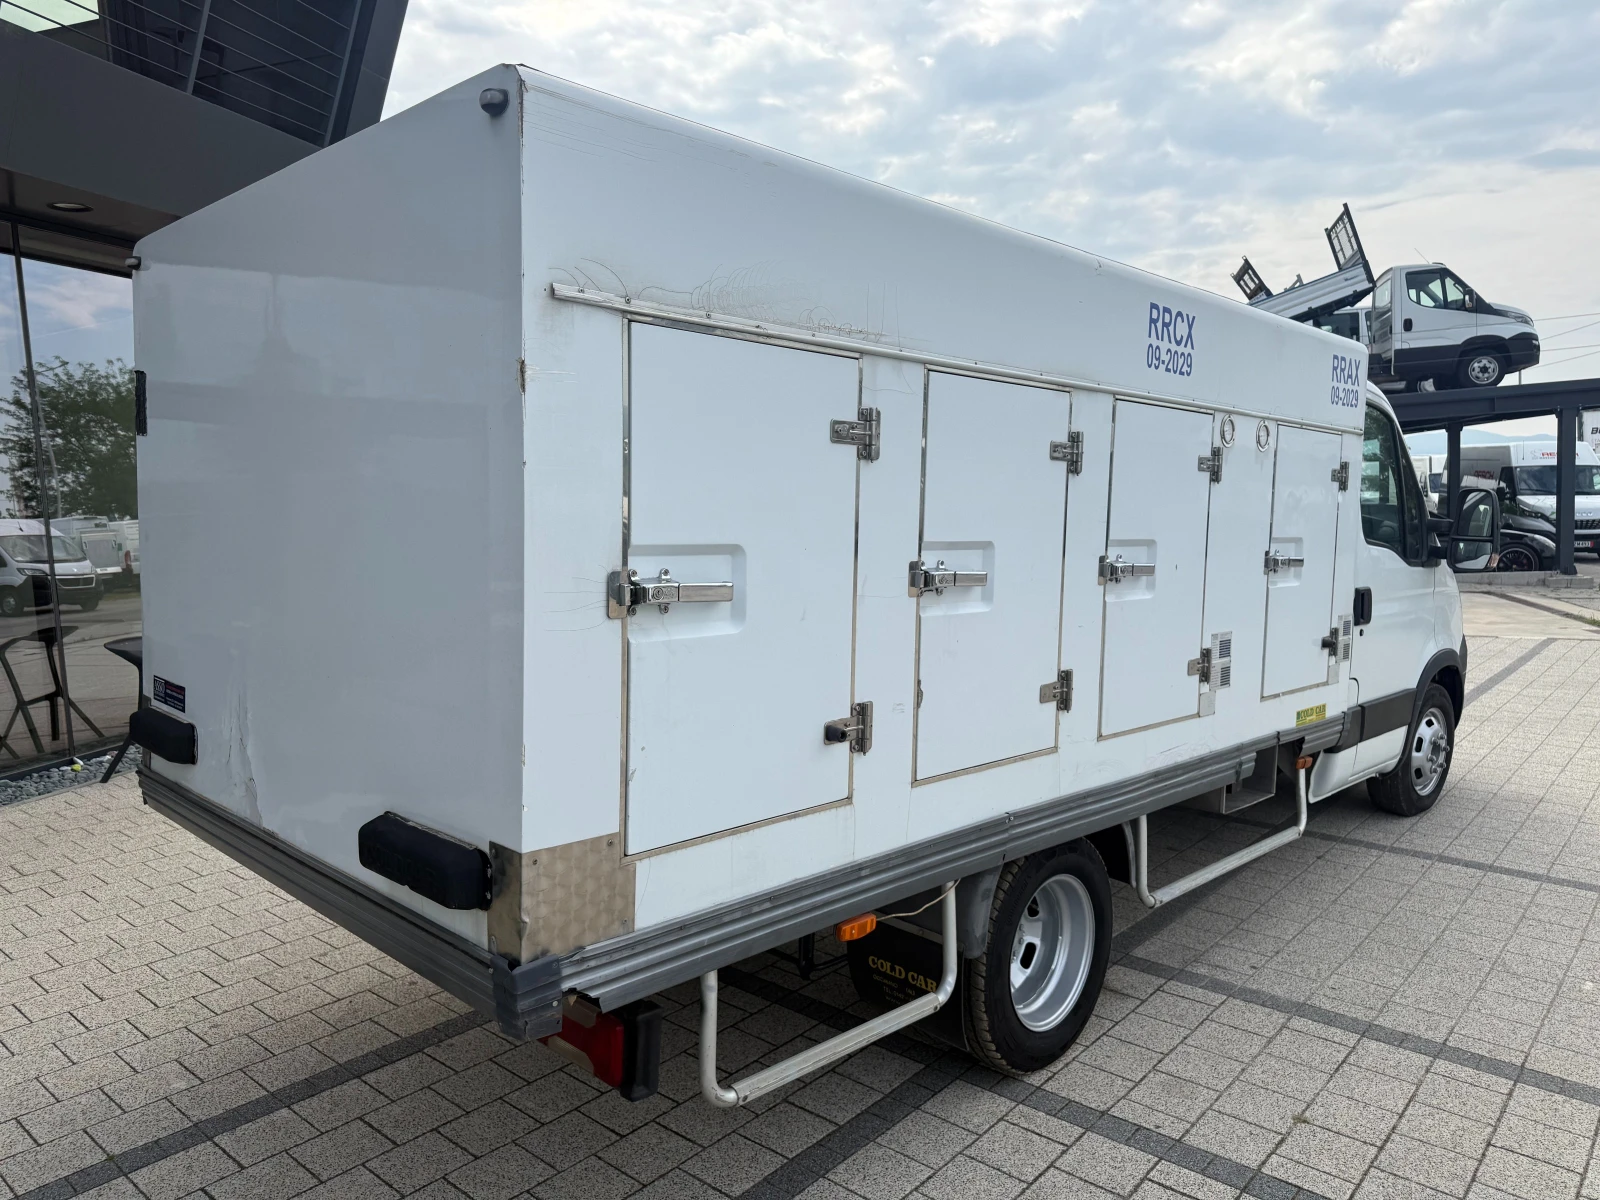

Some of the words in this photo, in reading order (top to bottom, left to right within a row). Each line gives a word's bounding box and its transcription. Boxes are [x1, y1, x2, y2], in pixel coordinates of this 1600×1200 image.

[1148, 301, 1196, 350] RRCX
[1146, 343, 1193, 377] 09-2029
[1331, 354, 1361, 387] RRAX
[1330, 385, 1359, 408] 09-2029
[868, 955, 906, 979] COLD
[907, 971, 937, 993] CAR
